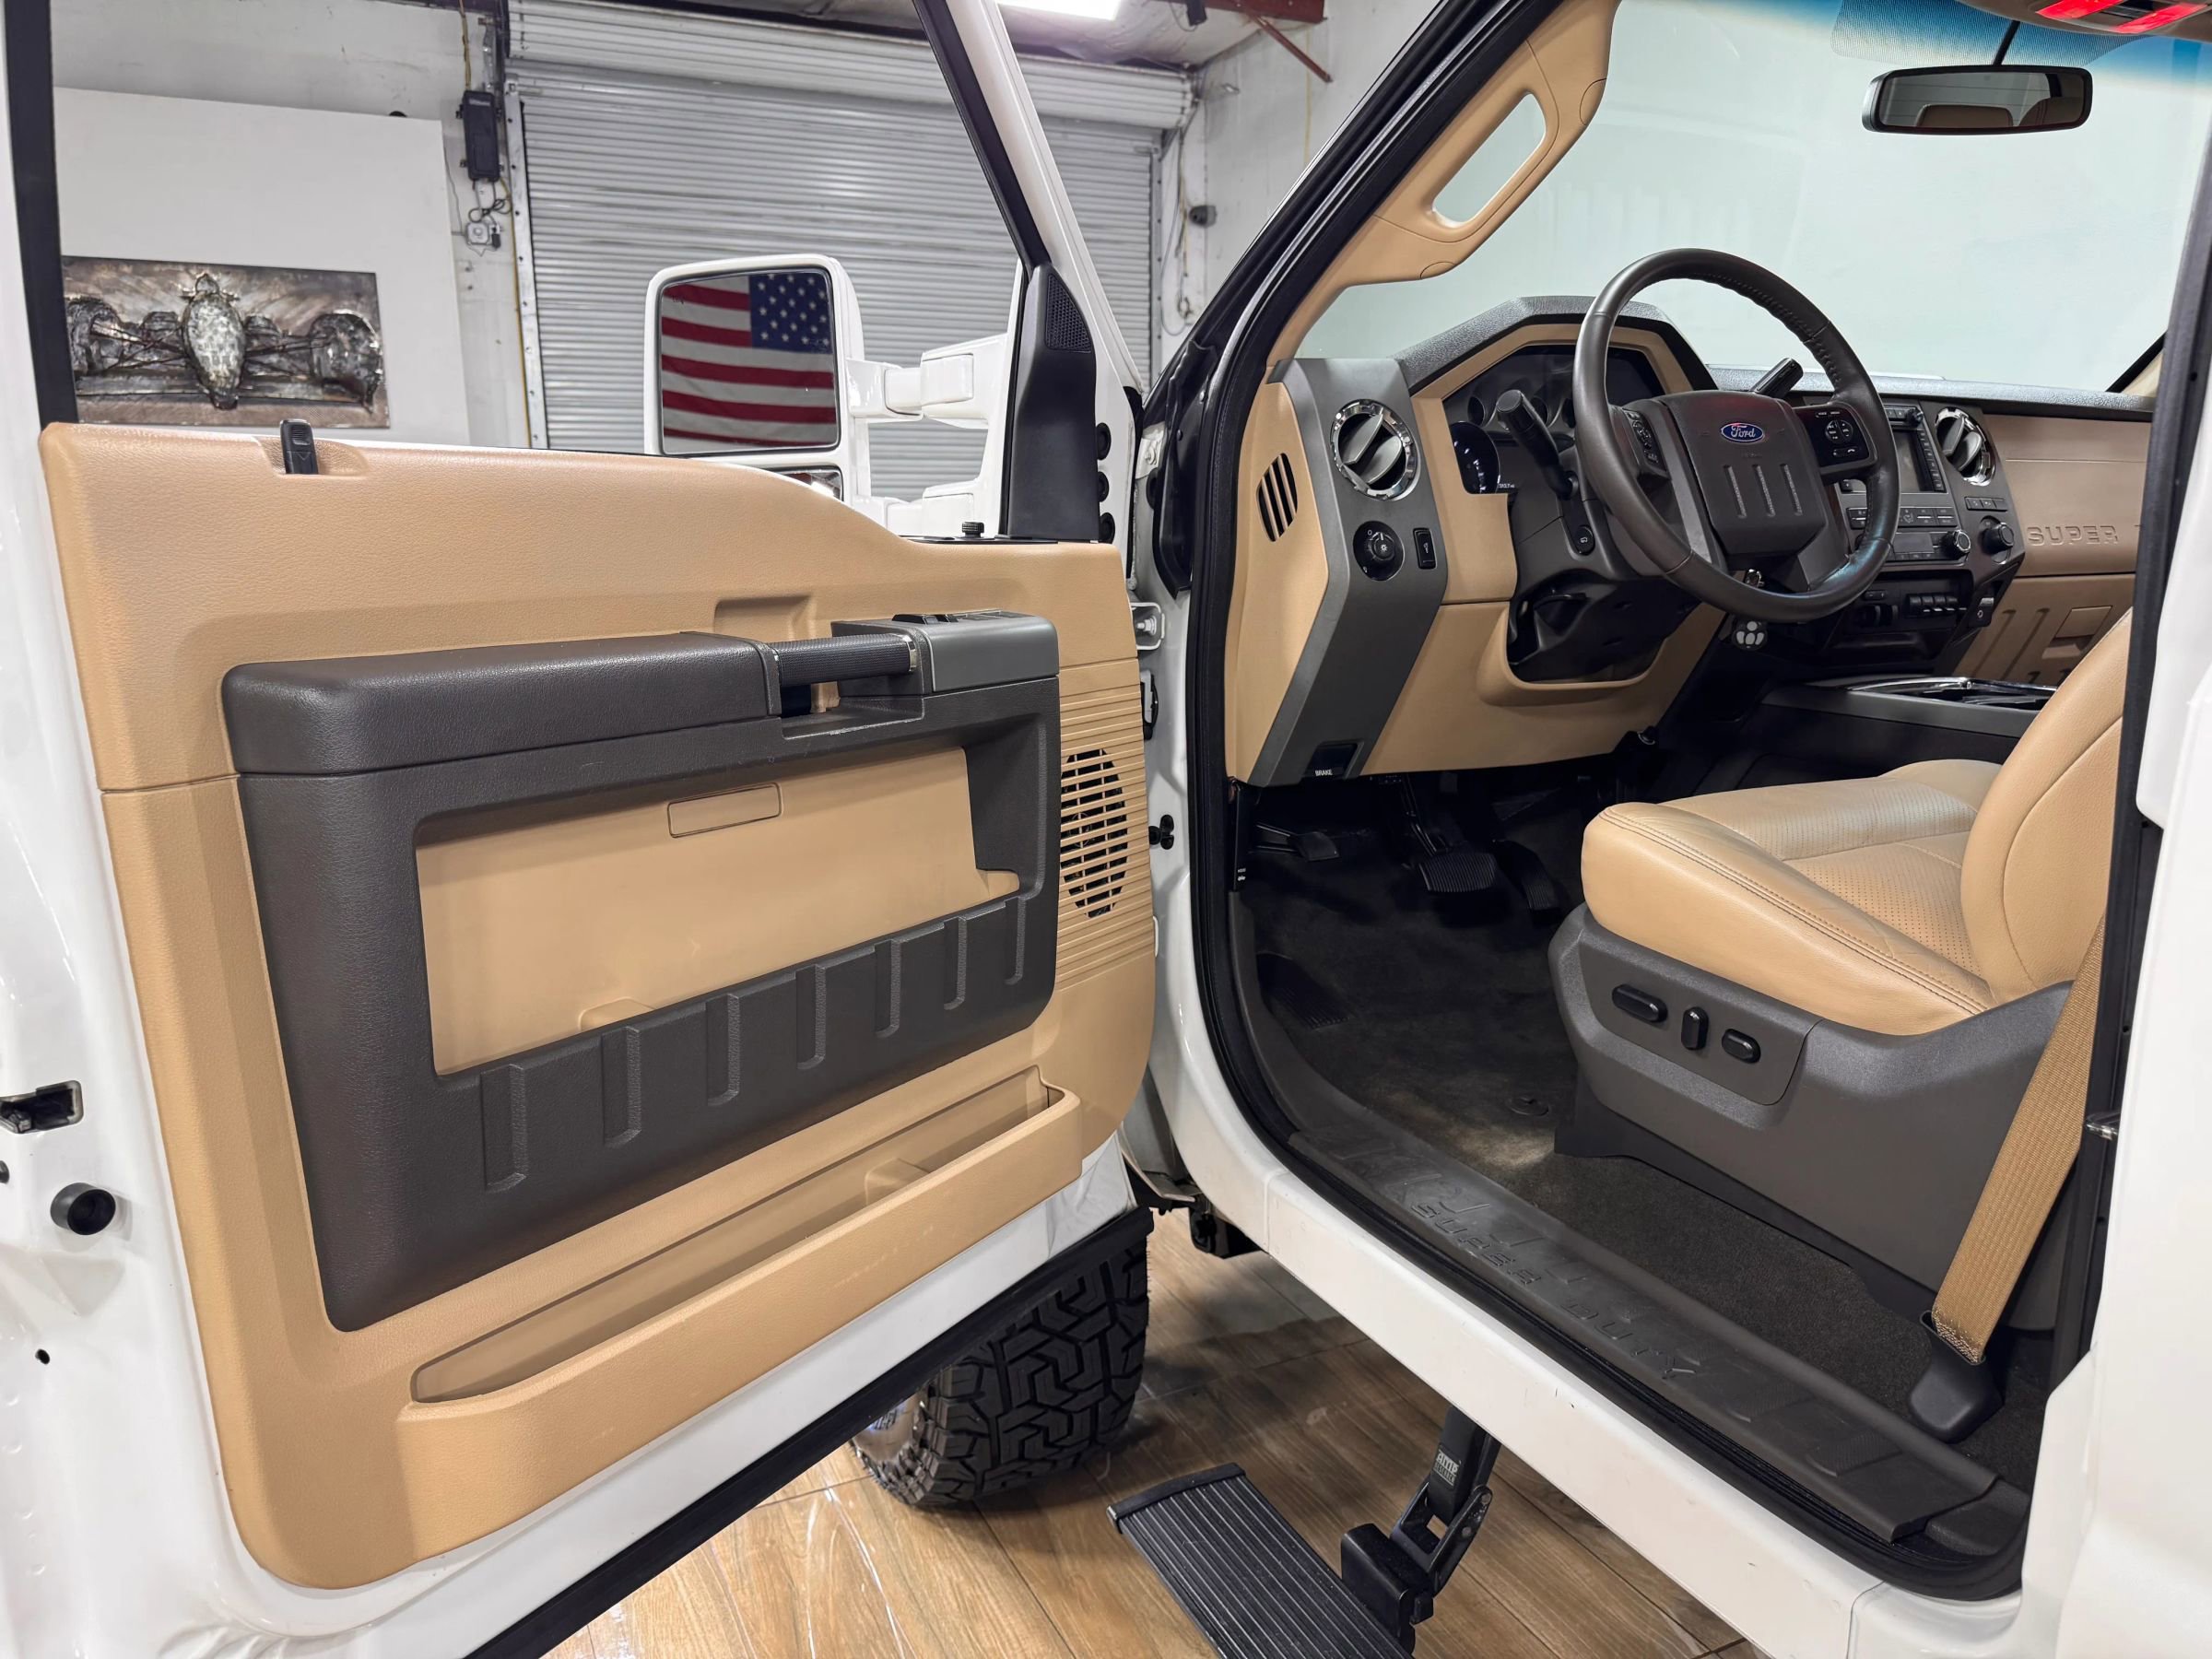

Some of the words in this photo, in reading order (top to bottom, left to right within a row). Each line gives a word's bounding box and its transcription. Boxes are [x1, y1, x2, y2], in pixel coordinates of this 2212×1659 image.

[1730, 425, 1756, 438] Ford
[2027, 525, 2119, 547] SUPER
[1314, 769, 1333, 777] BRAKE
[1410, 1200, 1542, 1285] SUPER
